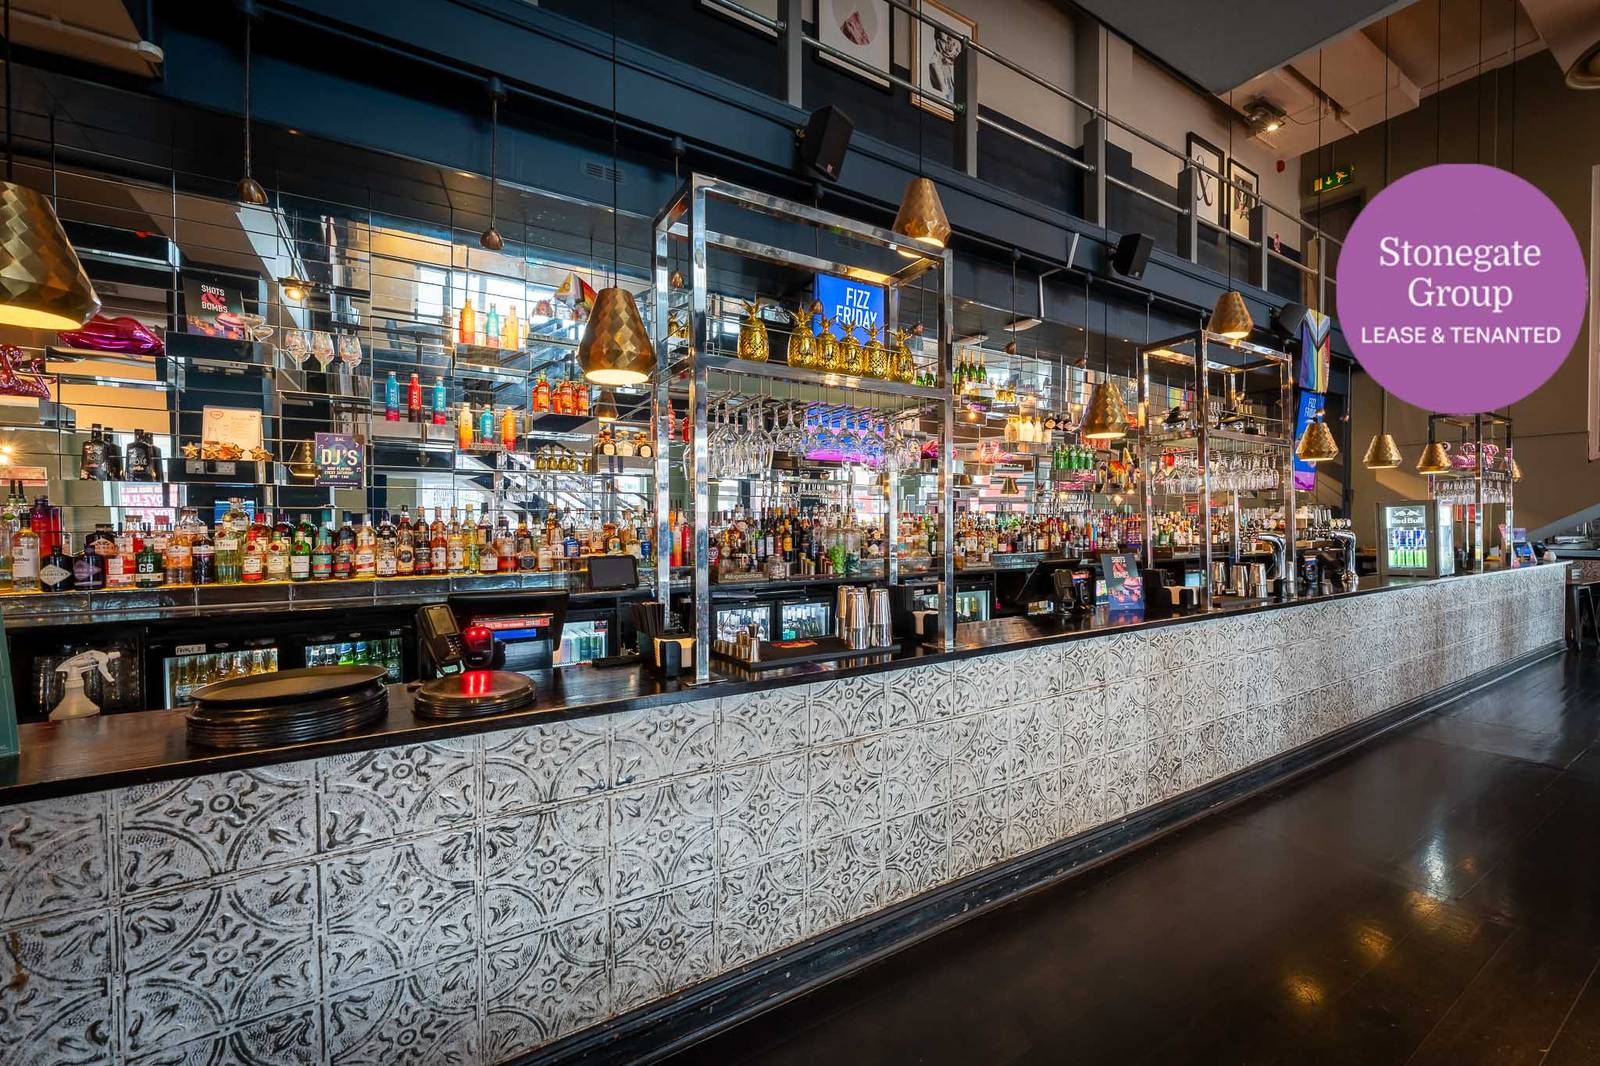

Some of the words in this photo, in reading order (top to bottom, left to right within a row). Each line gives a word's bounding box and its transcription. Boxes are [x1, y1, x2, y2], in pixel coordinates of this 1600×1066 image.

[201, 284, 225, 297] SHOTS
[845, 287, 871, 310] FIZZ
[201, 301, 228, 314] BOMBS
[835, 304, 878, 329] FRIDAY
[322, 448, 357, 465] DJ'S
[1392, 516, 1407, 524] Red
[1408, 516, 1423, 524] Bull
[138, 563, 154, 573] GB
